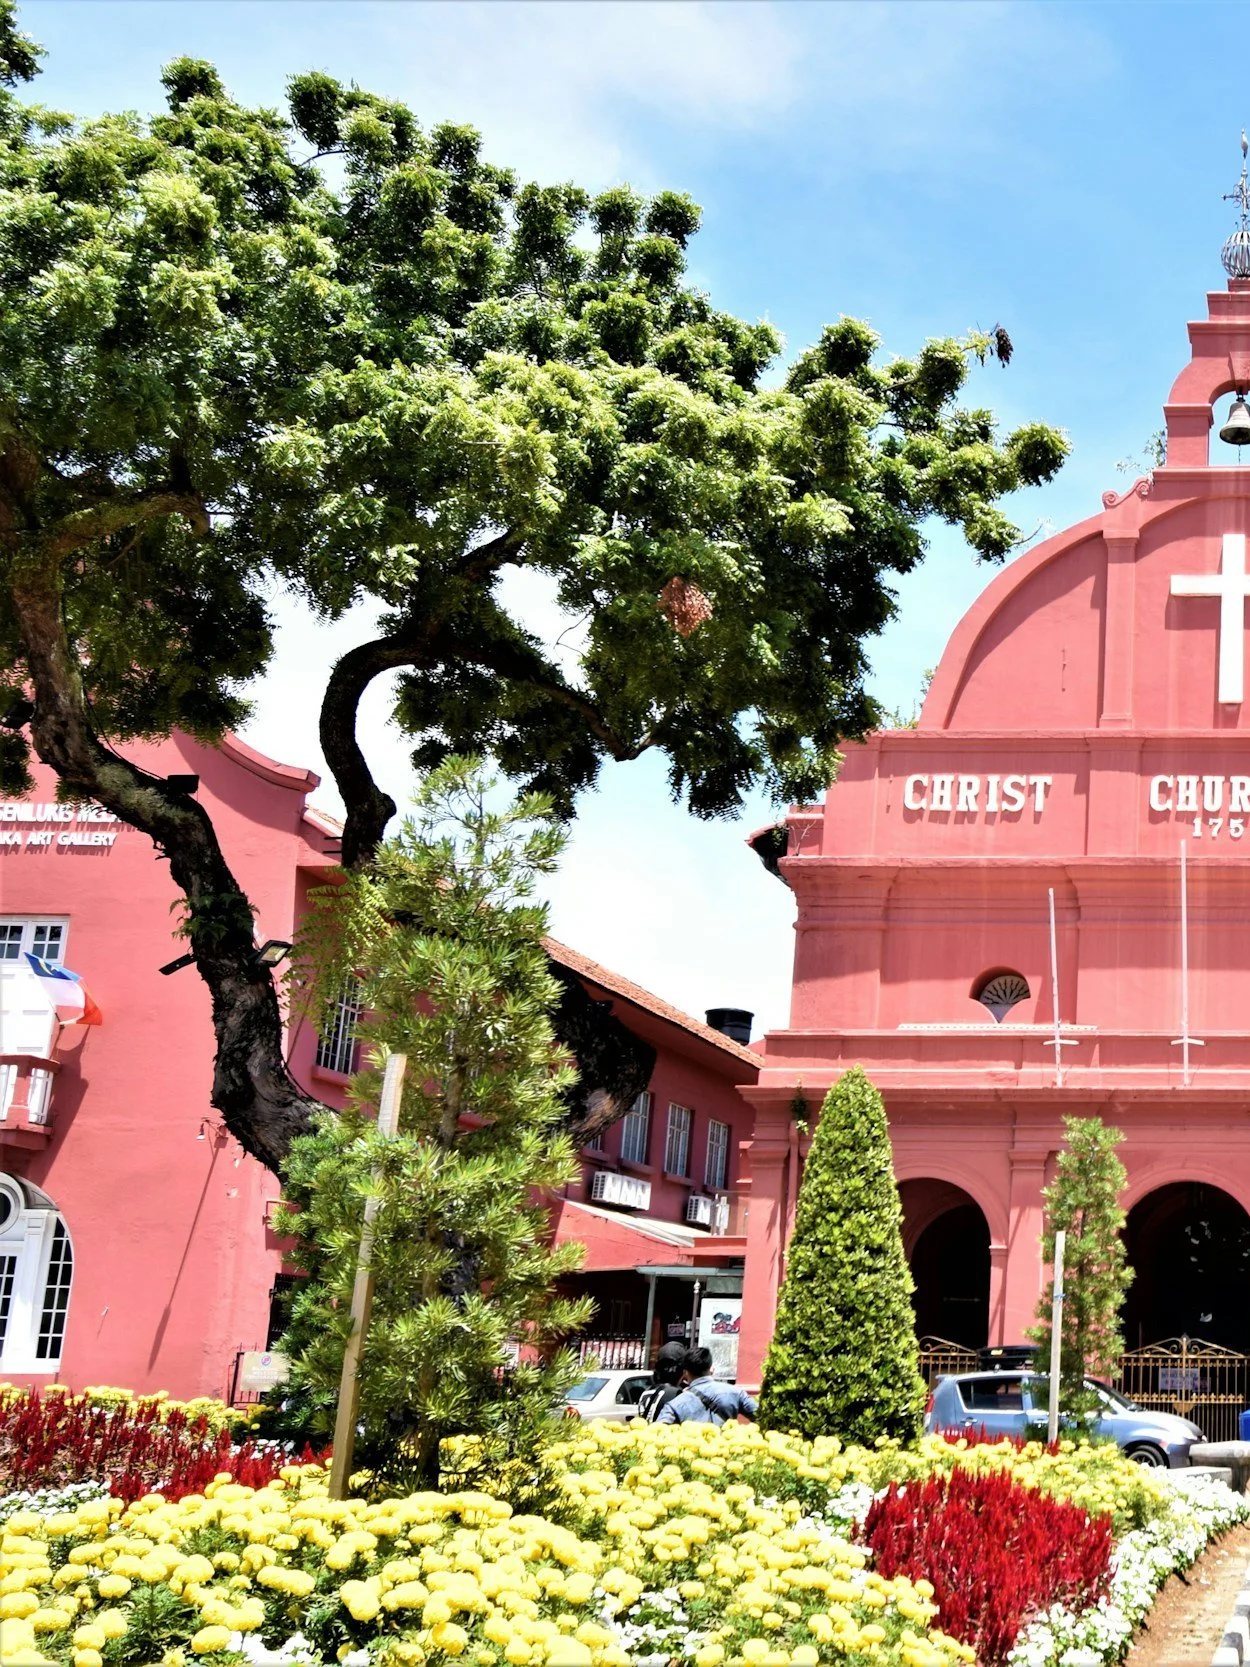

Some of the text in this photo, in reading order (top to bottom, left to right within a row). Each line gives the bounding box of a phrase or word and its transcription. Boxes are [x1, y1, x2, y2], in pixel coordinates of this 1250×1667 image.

[904, 774, 1053, 812] CHRIST
[0, 831, 118, 846] KA ART GALLERY
